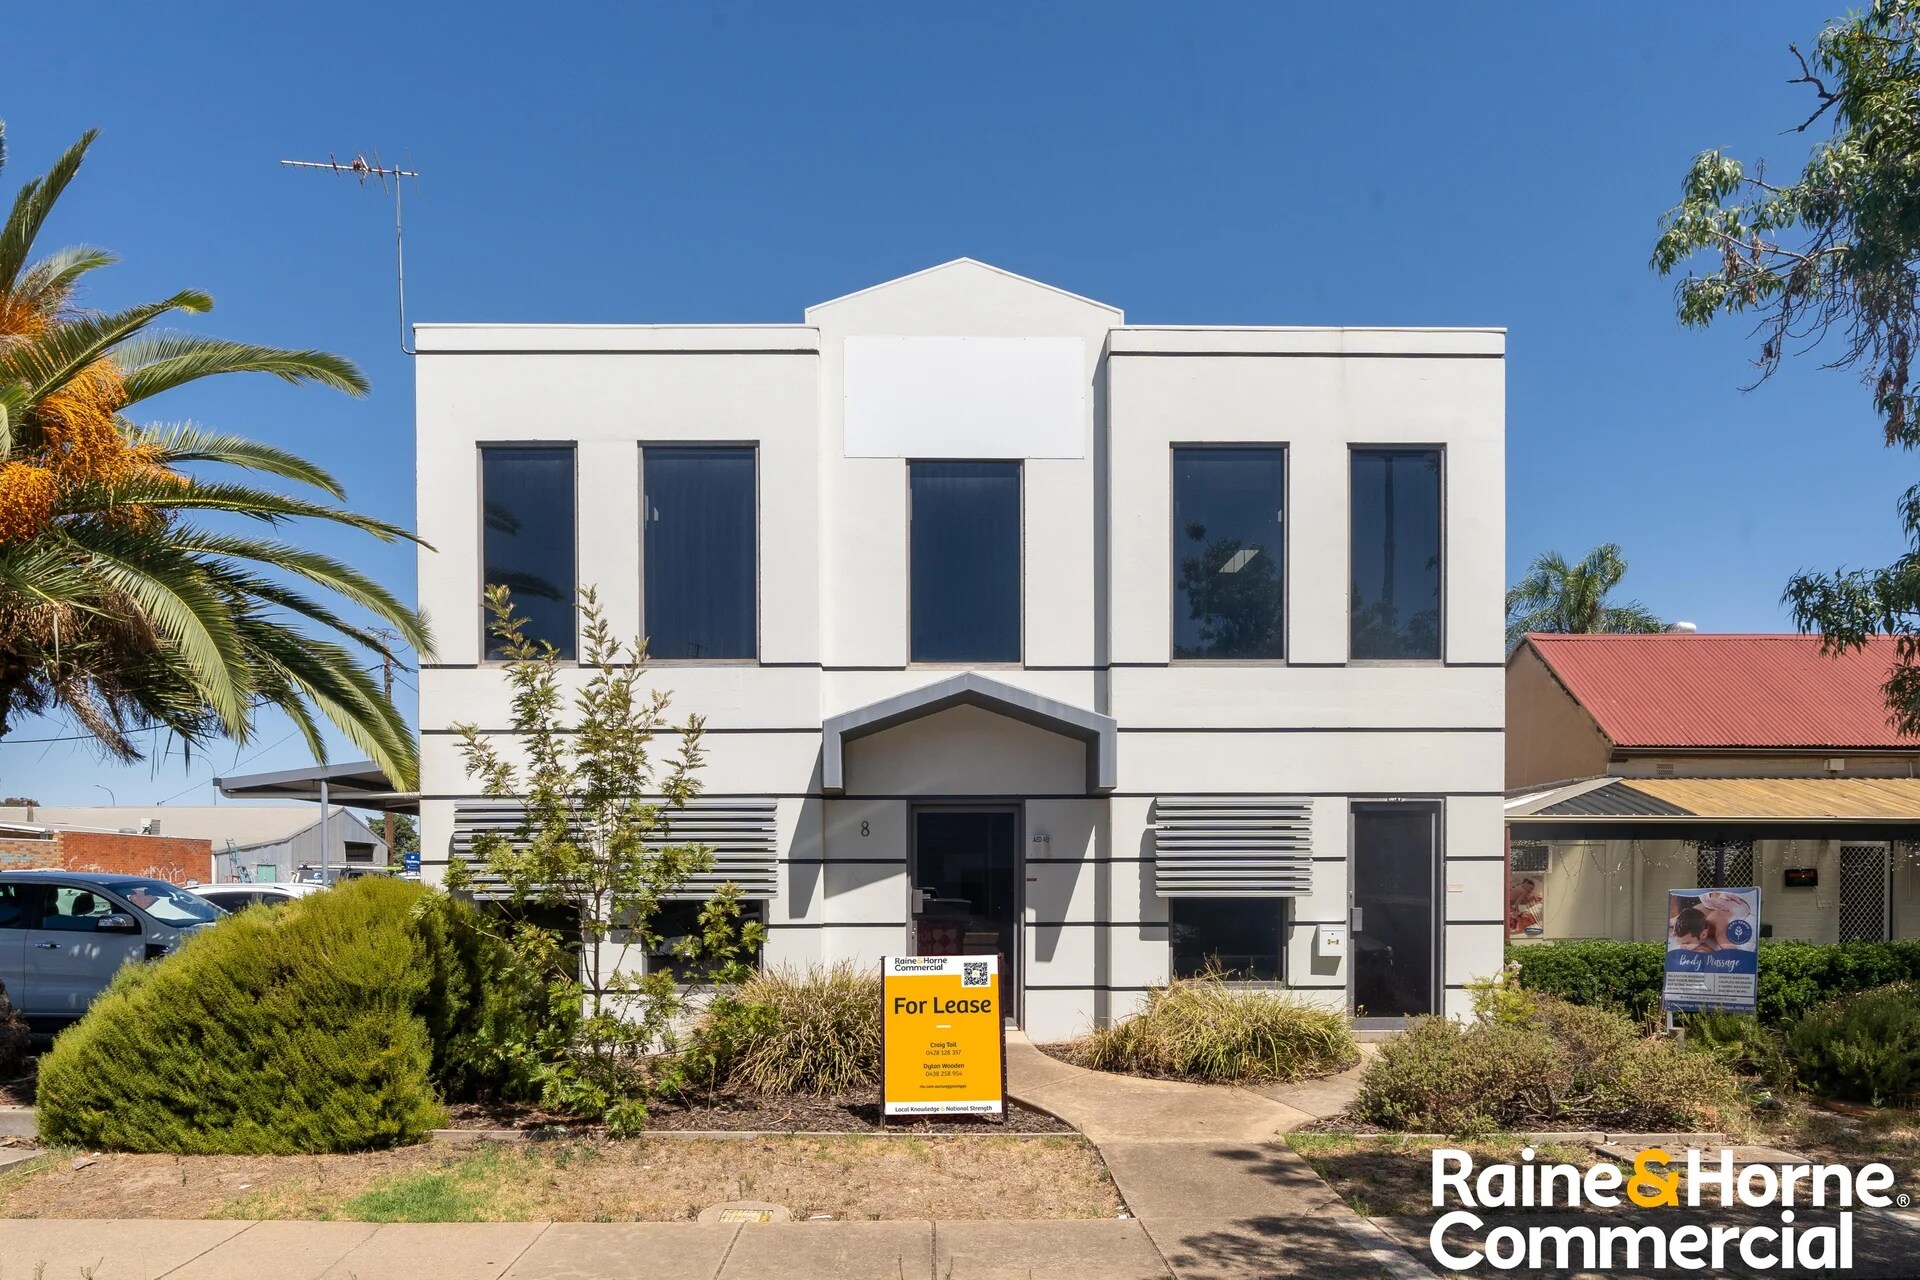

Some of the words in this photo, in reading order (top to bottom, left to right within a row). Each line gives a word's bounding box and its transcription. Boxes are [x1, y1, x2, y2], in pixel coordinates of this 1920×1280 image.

[861, 820, 870, 837] 8
[894, 964, 943, 972] Commercial
[1680, 954, 1702, 971] Body
[1706, 955, 1740, 972] Massage
[895, 998, 927, 1014] For
[934, 997, 991, 1014] Lease
